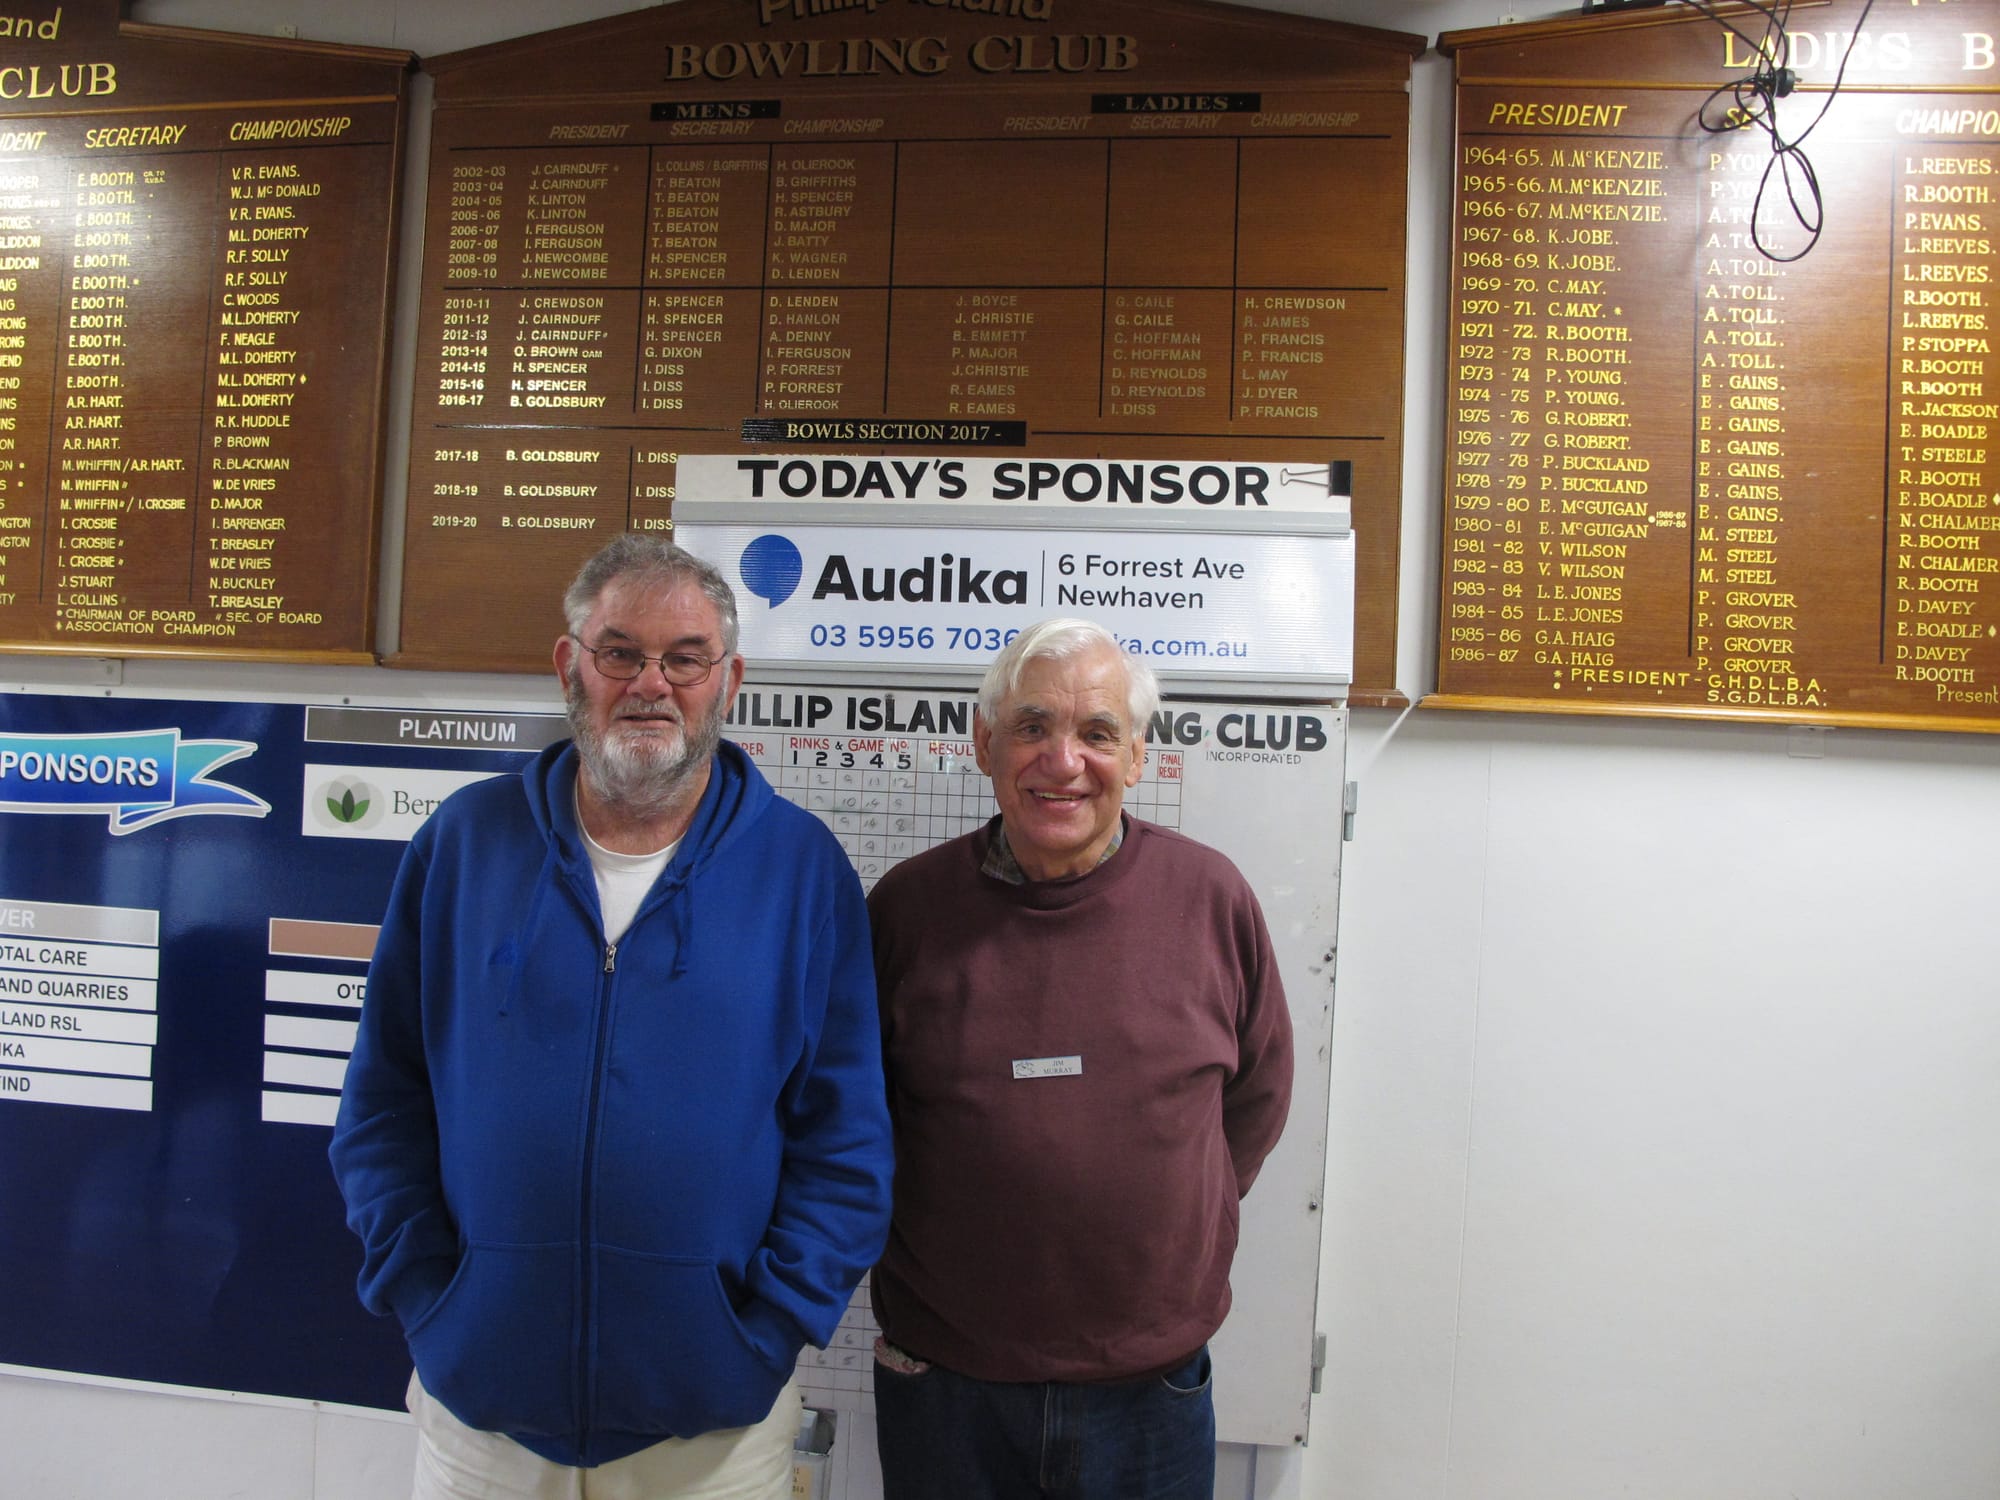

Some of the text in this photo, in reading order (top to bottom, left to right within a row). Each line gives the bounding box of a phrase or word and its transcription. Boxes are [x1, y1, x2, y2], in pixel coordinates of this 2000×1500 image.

[666, 32, 1139, 80] BOWLING CLUB
[0, 64, 116, 98] CLUB
[678, 104, 750, 117] MENS
[1125, 96, 1229, 111] LADIES
[1130, 114, 1222, 129] SECRETARY
[1251, 112, 1359, 127] CHAMPIONSHIP
[1490, 104, 1627, 127] PRESIDENT
[230, 117, 350, 140] CHAMPIONSHIP
[670, 121, 753, 136] SECRETARY
[784, 119, 884, 133] CHAMPIONSHIP
[1004, 116, 1092, 130] PRESIDENT
[85, 125, 186, 148] SECRETARY
[549, 125, 629, 138] PRESIDENT
[252, 249, 289, 262] SOLLY
[446, 299, 489, 308] 2010-11
[535, 298, 603, 308] CREWDSON
[649, 296, 723, 306] H. SPENCER
[788, 296, 838, 307] LENDEN
[1246, 298, 1345, 309] H. CREWDSON
[972, 313, 1033, 323] CHRISTIE
[235, 333, 275, 345] NEAGLE
[531, 346, 577, 357] BROWN
[663, 347, 702, 357] DIXON
[439, 395, 483, 405] 2016-17
[510, 396, 605, 407] B. GOLDSBURY
[654, 399, 682, 409] DISS
[1258, 405, 1319, 418] FRANCIS
[787, 424, 989, 440] BOWLS SECTION 2017
[228, 436, 269, 447] BROWN
[435, 451, 478, 461] 2017-18
[506, 450, 599, 462] B. GOLDSBURY
[648, 453, 677, 463] DISS
[1922, 448, 1986, 463] STEELE
[1563, 456, 1649, 472] BUCKLAND
[738, 459, 1269, 505] TODAY'S SPONSOR
[434, 485, 477, 495] 2018-19
[504, 486, 597, 496] B. GOLDSBURY
[223, 518, 285, 529] BARRENGER
[433, 516, 476, 527] 2019-20
[502, 517, 595, 528] B. GOLDSBURY
[1726, 529, 1777, 543] STEEL
[71, 538, 115, 549] CROSBIE
[222, 539, 274, 549] BREASLEY
[1561, 543, 1626, 557] WILSON
[1059, 554, 1244, 579] 6 Forrest Ave
[70, 576, 114, 587] STUART
[812, 553, 1027, 604] Audika
[1919, 578, 1978, 592] BOOTH
[1059, 584, 1202, 608] Newhaven
[1727, 592, 1797, 607] GROVER
[1919, 600, 1975, 614] DAVEY
[66, 609, 195, 621] CHAIRMAN OF BOARD
[226, 612, 321, 623] SEC. OF BOARD
[66, 621, 235, 635] ASSOCIATION CHAMPION
[1917, 623, 1982, 638] BOADLE
[811, 625, 845, 646] 03
[859, 626, 934, 648] 5956
[1572, 668, 1690, 686] PRESIDENT
[846, 696, 978, 734] ISLAN
[400, 719, 516, 742] PLATINUM
[1216, 714, 1327, 751] CLUB
[791, 737, 829, 750] RINKS
[834, 741, 843, 750] &
[848, 739, 883, 752] GAME
[793, 750, 911, 769] 1 2 3 4 5
[1161, 754, 1182, 765] FINAL
[1207, 752, 1301, 764] INCORPORATED
[0, 751, 159, 786] PONSORS
[1159, 767, 1182, 779] RESULT
[393, 791, 440, 815] Ber
[40, 949, 86, 966] CARE
[38, 981, 128, 1000] QUARRIES
[51, 1016, 81, 1031] RSL
